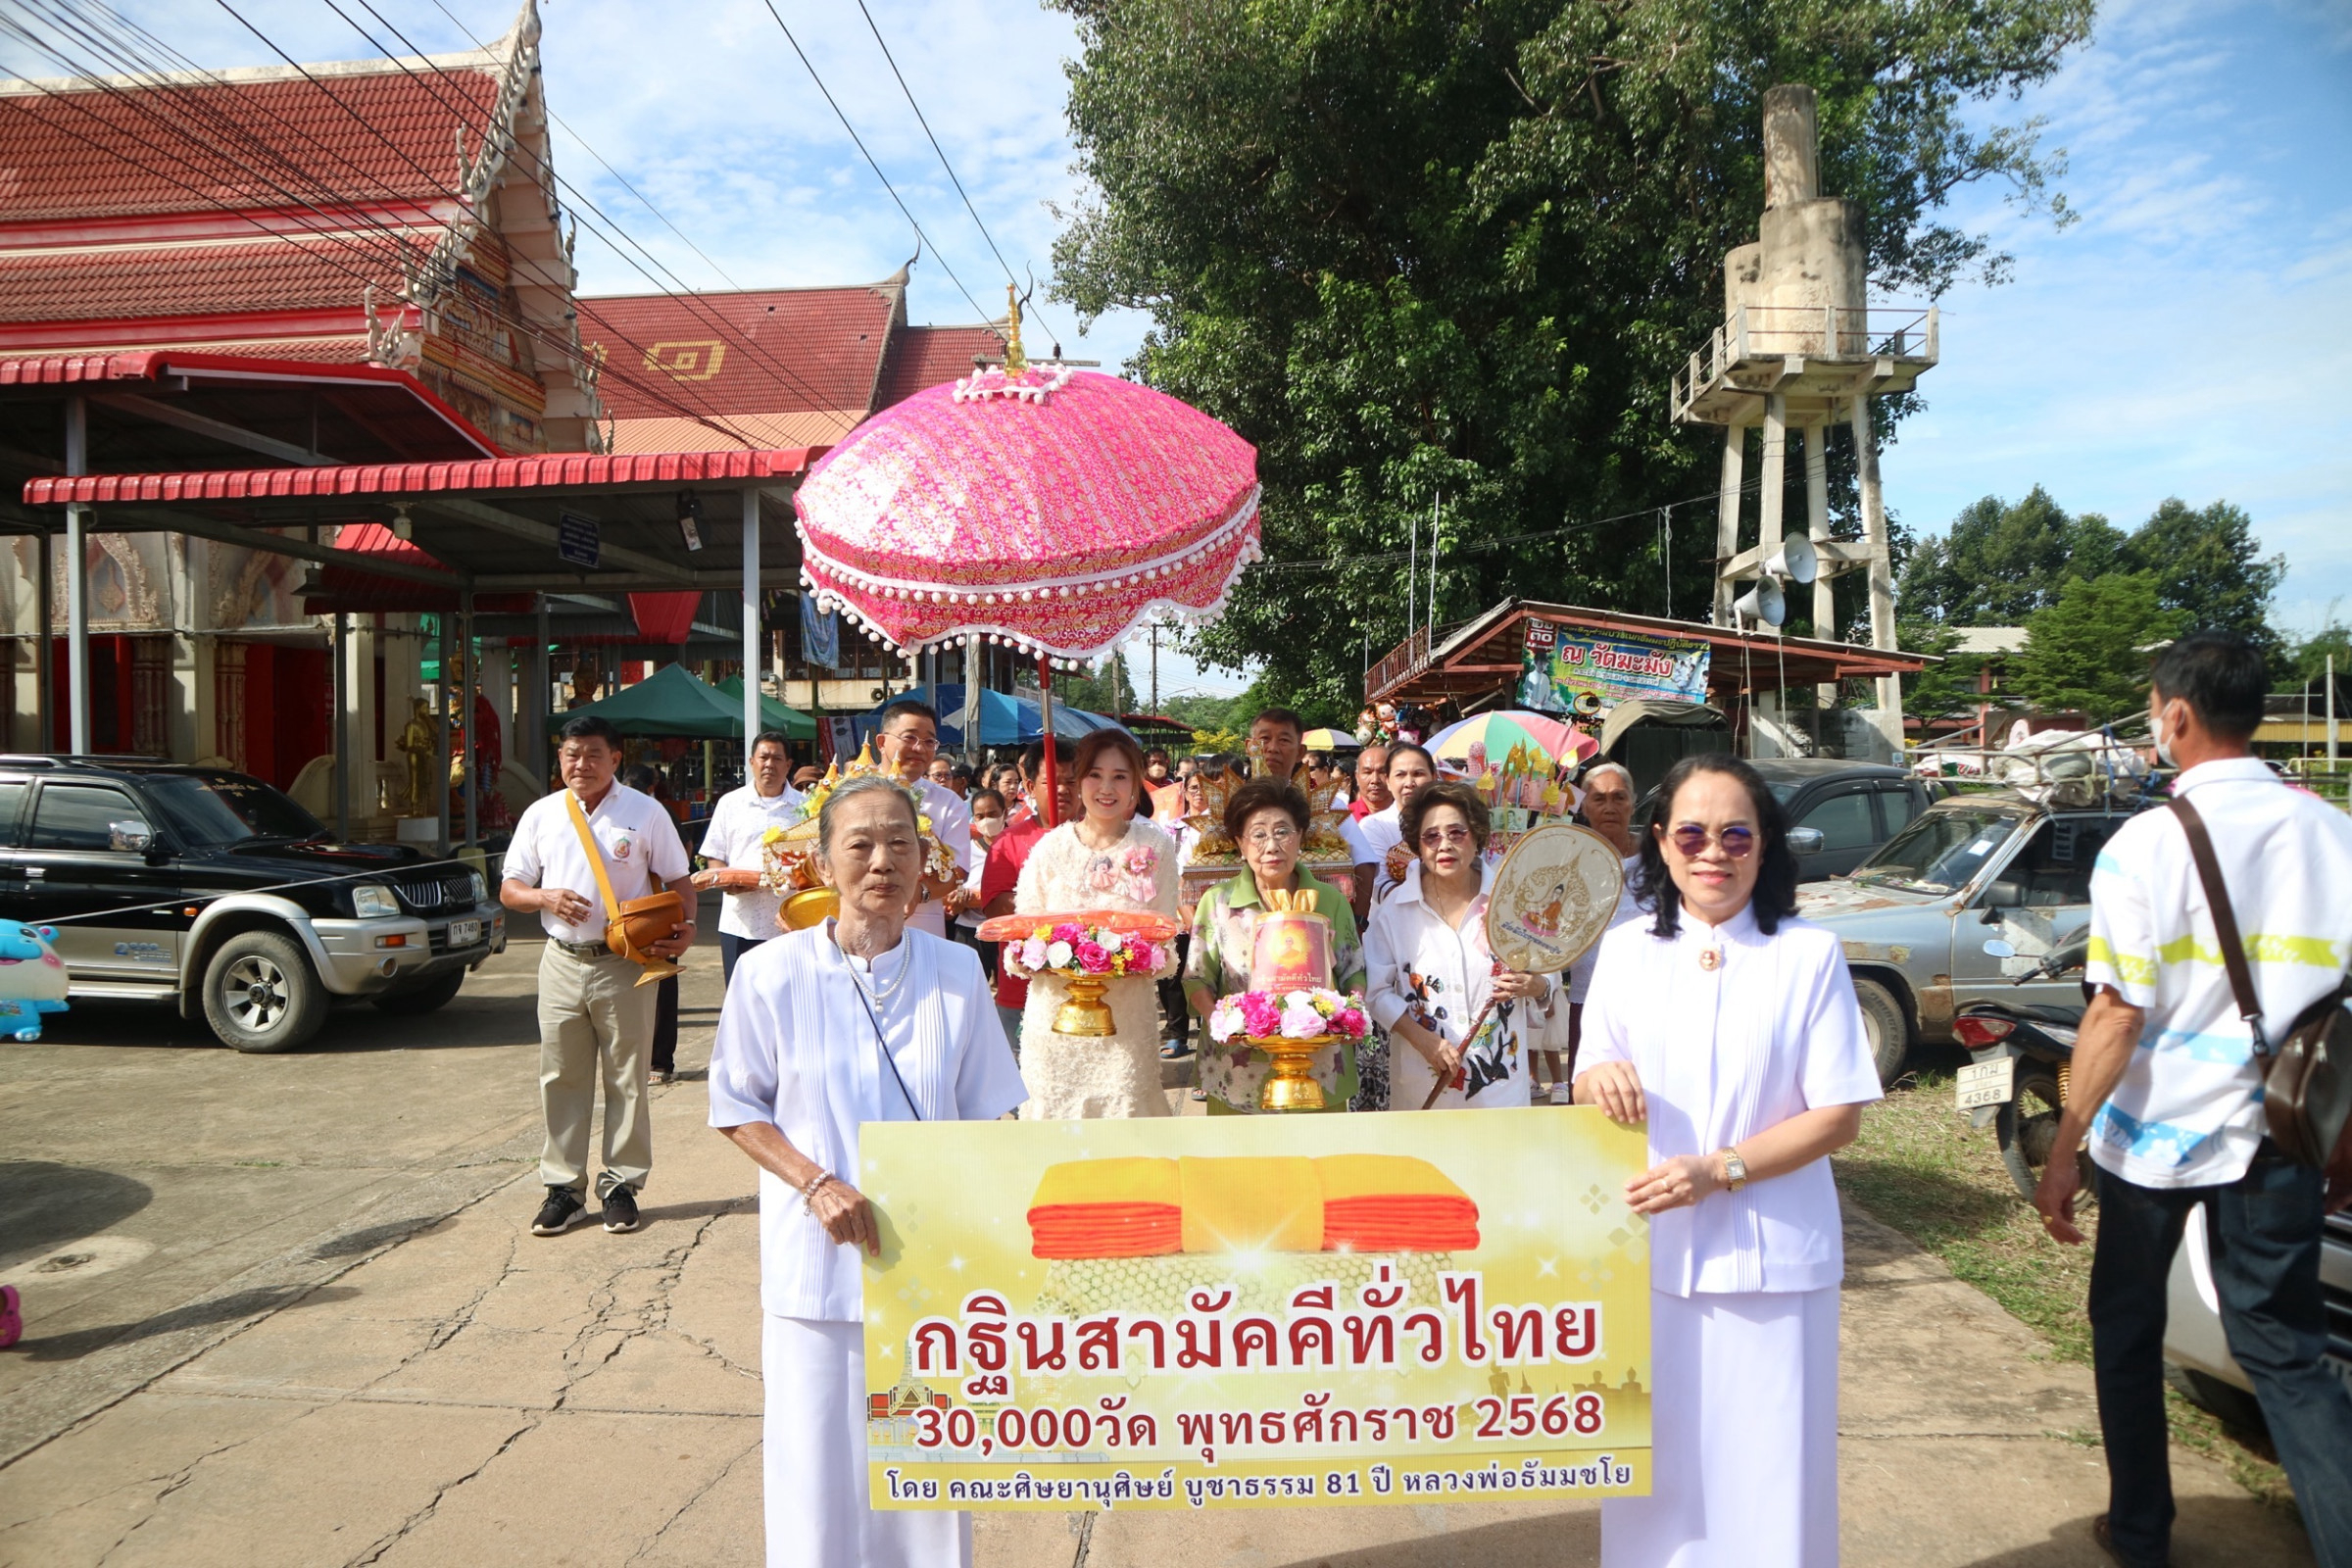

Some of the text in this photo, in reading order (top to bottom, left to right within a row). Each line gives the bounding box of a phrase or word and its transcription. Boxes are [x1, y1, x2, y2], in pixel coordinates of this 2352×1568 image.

[1562, 642, 1673, 677] ณ วัดฆะมัง
[1965, 1089, 2001, 1104] 4368
[914, 1264, 1598, 1396] กฐินสามัคคีทั่วไทย
[915, 1392, 1602, 1464] 30,000วัด พุทธศักราช 2568
[887, 1456, 1631, 1506] โดย คณะศิษยานุศิษย์ บูชาธรรม 81 ปี หลวงพ่อธัมมชโย
